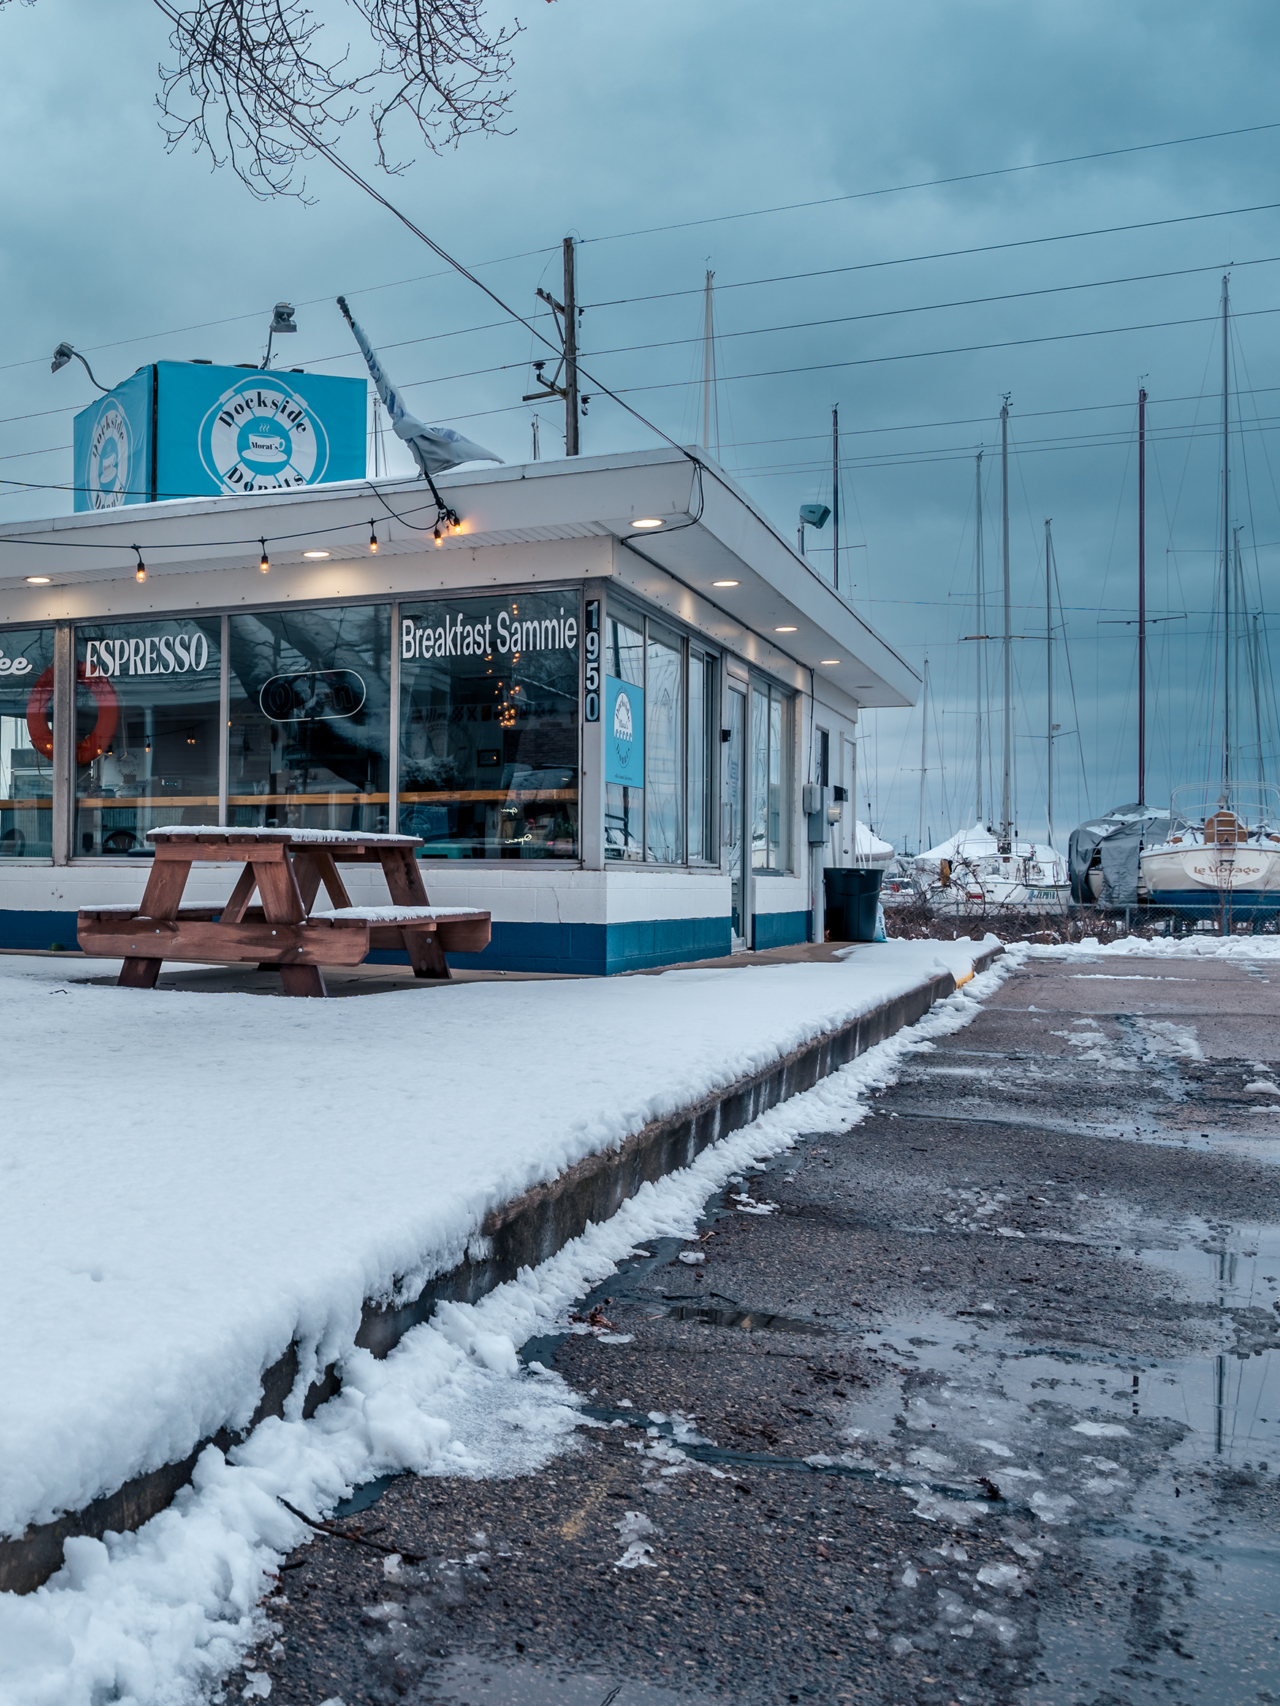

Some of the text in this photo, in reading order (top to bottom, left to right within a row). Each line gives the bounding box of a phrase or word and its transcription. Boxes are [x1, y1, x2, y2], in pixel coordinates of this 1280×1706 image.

[218, 391, 307, 434] Dockside
[251, 441, 279, 450] Morat's
[402, 607, 577, 659] Breakfast Sammie
[85, 633, 208, 677] ESPRESSO
[586, 601, 599, 721] 1950
[1194, 866, 1260, 876] Le Voyage
